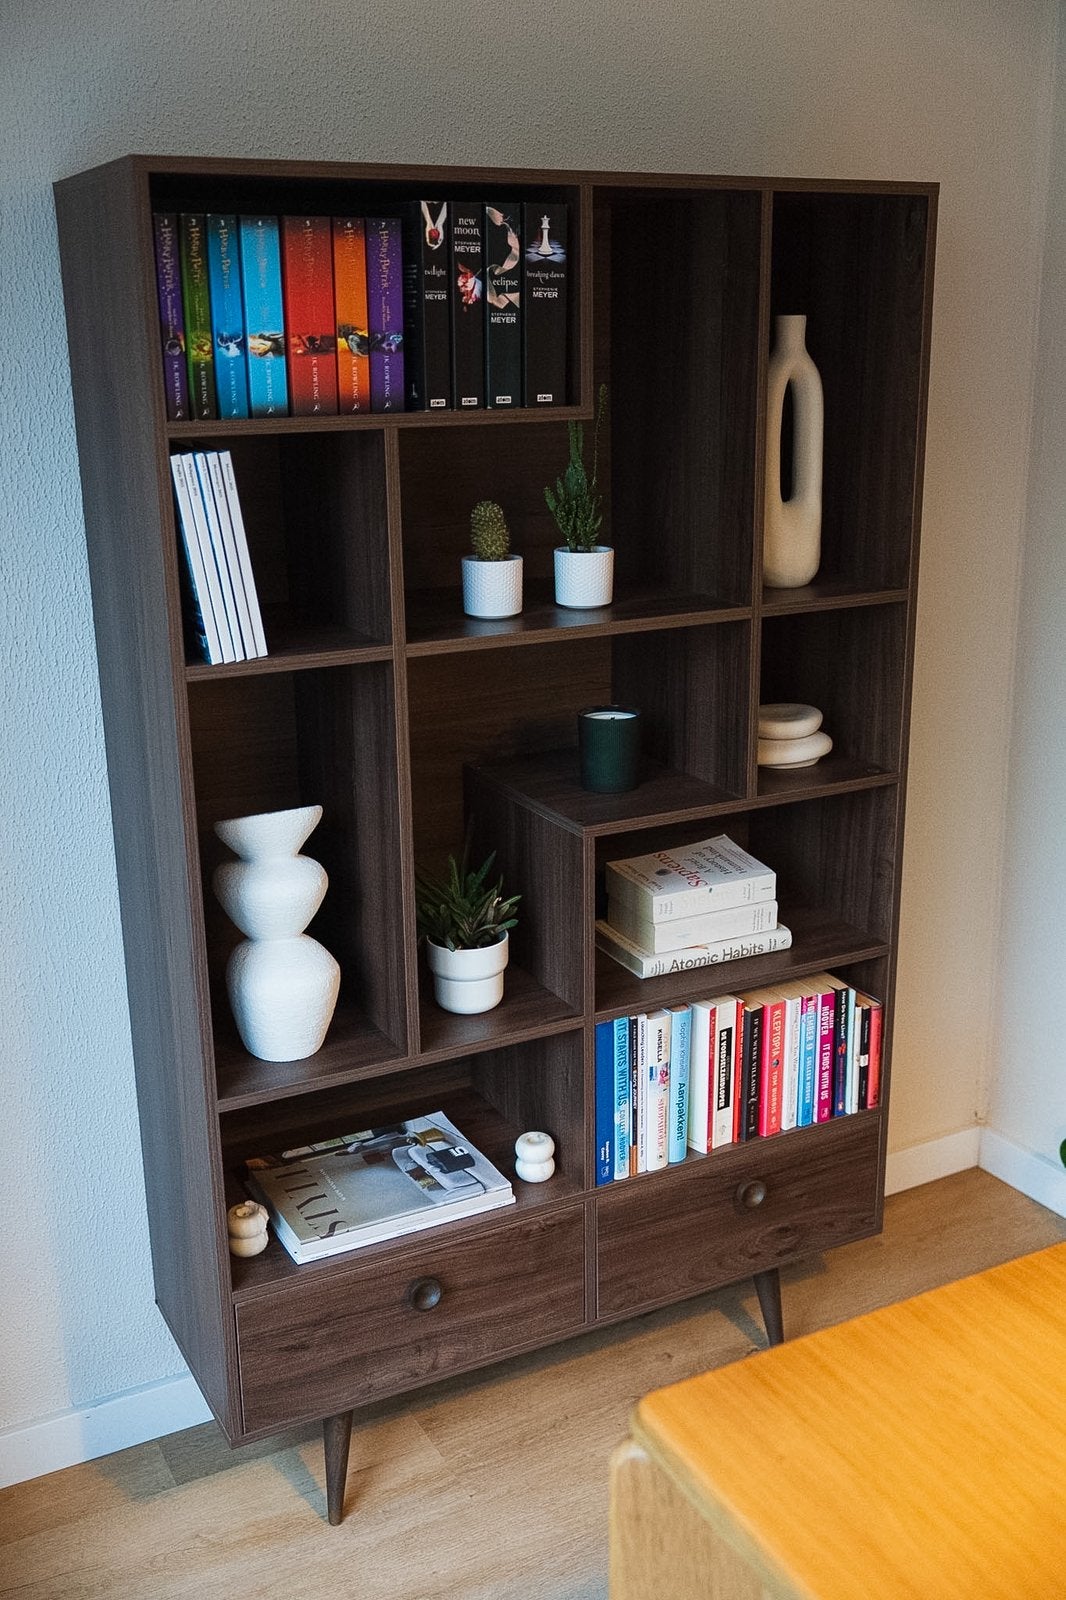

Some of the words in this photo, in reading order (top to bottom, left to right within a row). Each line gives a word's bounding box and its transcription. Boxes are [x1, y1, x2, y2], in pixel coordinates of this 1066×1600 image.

[161, 228, 172, 258] HARRY
[189, 228, 200, 258] HARRY
[220, 229, 228, 258] HARRY
[379, 231, 389, 258] HARRY
[454, 227, 480, 236] moon
[380, 258, 390, 288] POTTER
[424, 265, 447, 276] twilight
[527, 270, 549, 283] breaking
[493, 277, 518, 292] eclipse
[653, 852, 708, 888] Sapiens
[702, 846, 747, 874] Humankind
[706, 858, 732, 875] History
[670, 952, 718, 972] Atomic
[722, 944, 764, 960] Habits
[618, 1020, 626, 1032] IT
[754, 1027, 758, 1039] WE
[772, 1010, 781, 1056] KLEPTOPIA
[806, 1000, 815, 1040] NOVEMBER
[721, 1031, 727, 1040] DE
[618, 1033, 626, 1066] STARTS
[822, 1052, 830, 1071] ENDS
[618, 1068, 626, 1095] WITH
[719, 1040, 727, 1108] VOEDSELZANDLOPER
[618, 1096, 627, 1106] US
[821, 1090, 828, 1100] US
[676, 1082, 685, 1141] Aanpakken!
